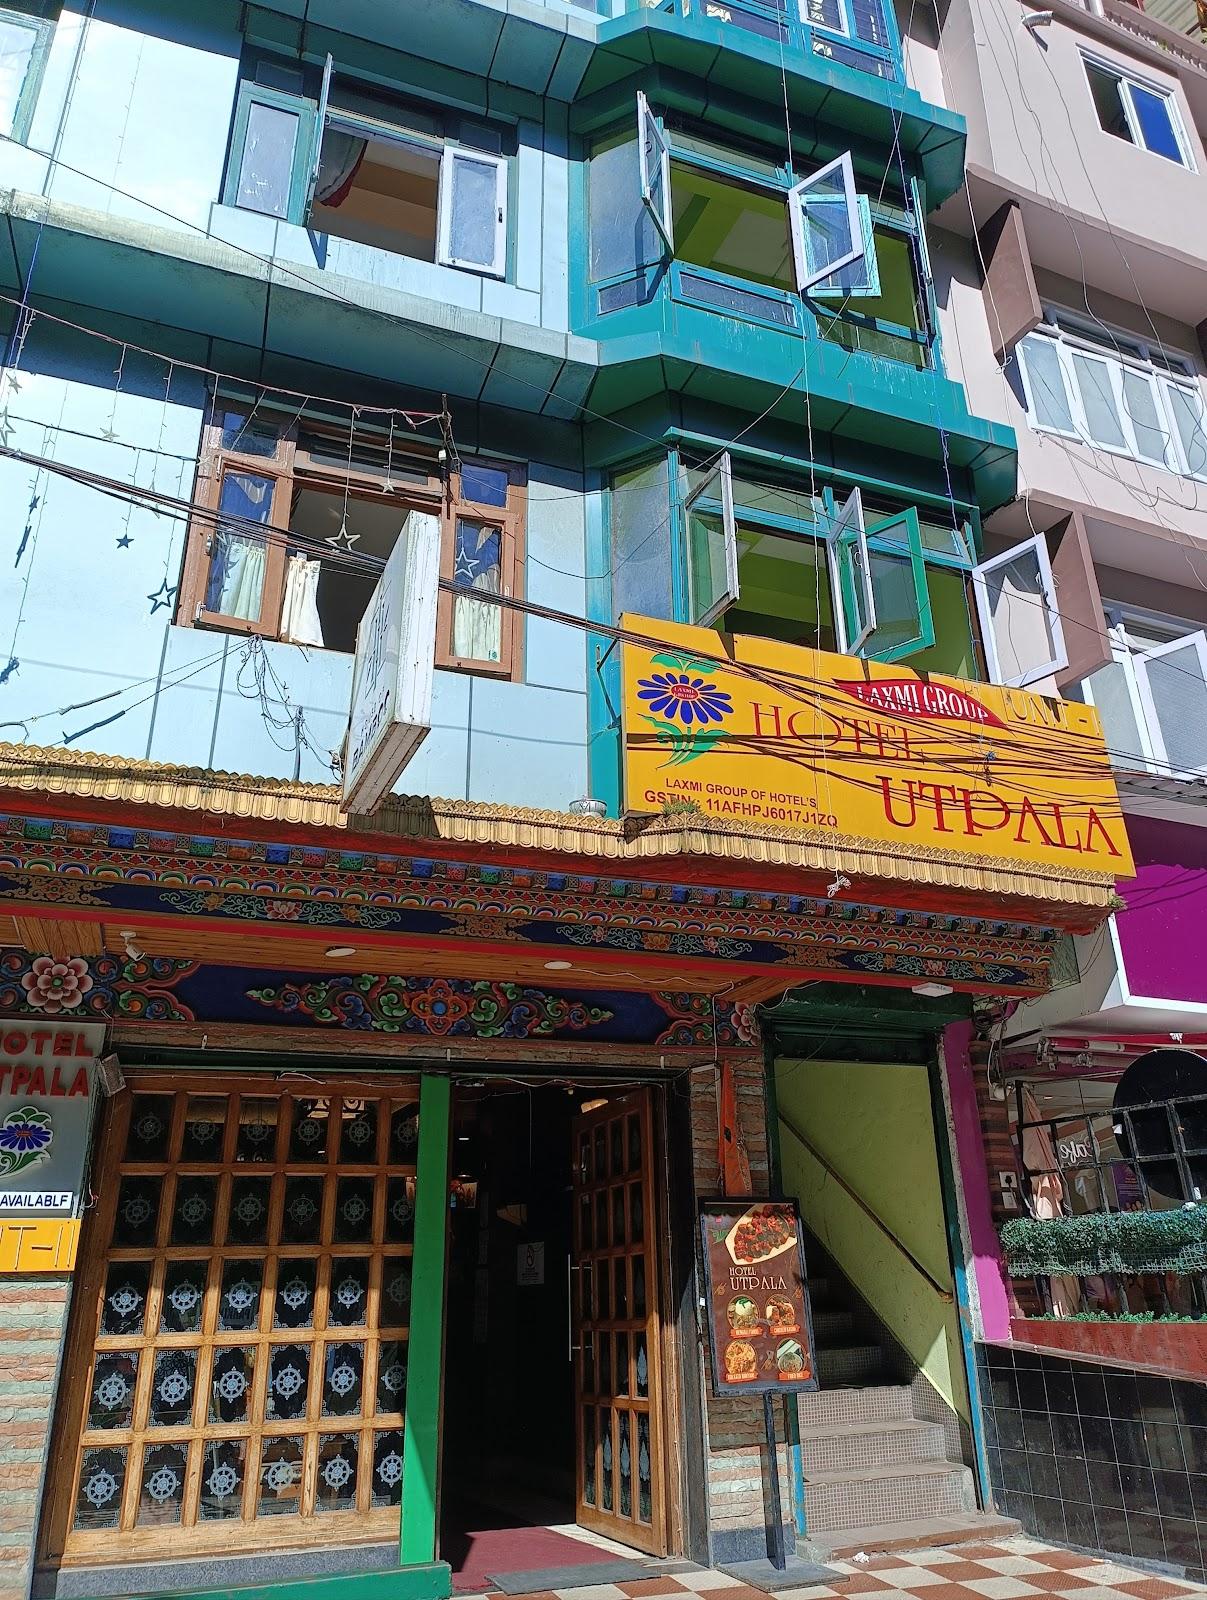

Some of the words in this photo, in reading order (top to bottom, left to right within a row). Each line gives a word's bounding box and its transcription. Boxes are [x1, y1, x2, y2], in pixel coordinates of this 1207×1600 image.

[856, 684, 920, 714] LAXMI
[923, 685, 989, 720] GROUP
[749, 702, 925, 765] HOTEL
[665, 777, 703, 792] LAXMI
[705, 783, 748, 799] GROUP
[750, 789, 766, 801] OF
[769, 792, 817, 809] HOTEL'S
[875, 775, 1122, 857] UTPALA
[0, 1031, 94, 1057] OTEL
[730, 1276, 788, 1291] UTPALA
